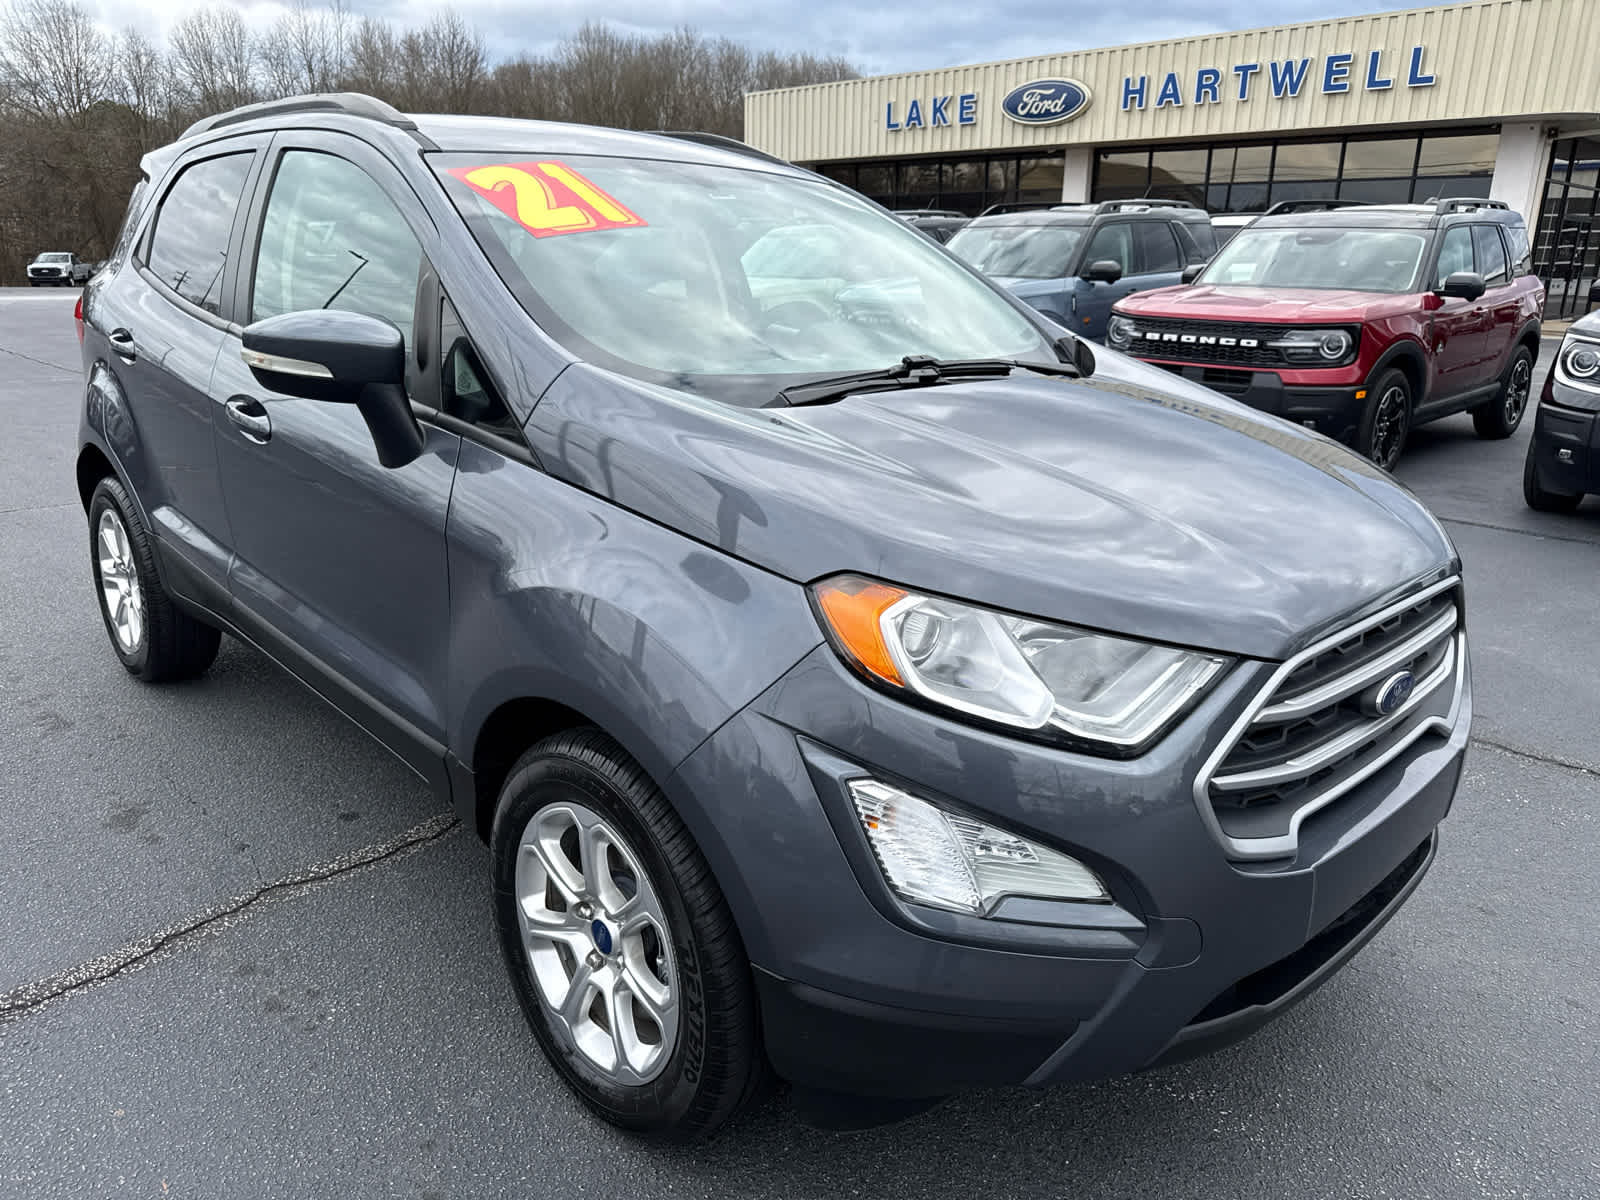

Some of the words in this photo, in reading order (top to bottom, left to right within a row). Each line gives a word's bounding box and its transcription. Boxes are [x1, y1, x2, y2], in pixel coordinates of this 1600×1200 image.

[886, 93, 977, 130] LAKE
[1017, 88, 1068, 115] Ford
[1121, 45, 1436, 111] HARTWELL
[464, 162, 640, 231] 21
[1145, 332, 1259, 347] BRONCO
